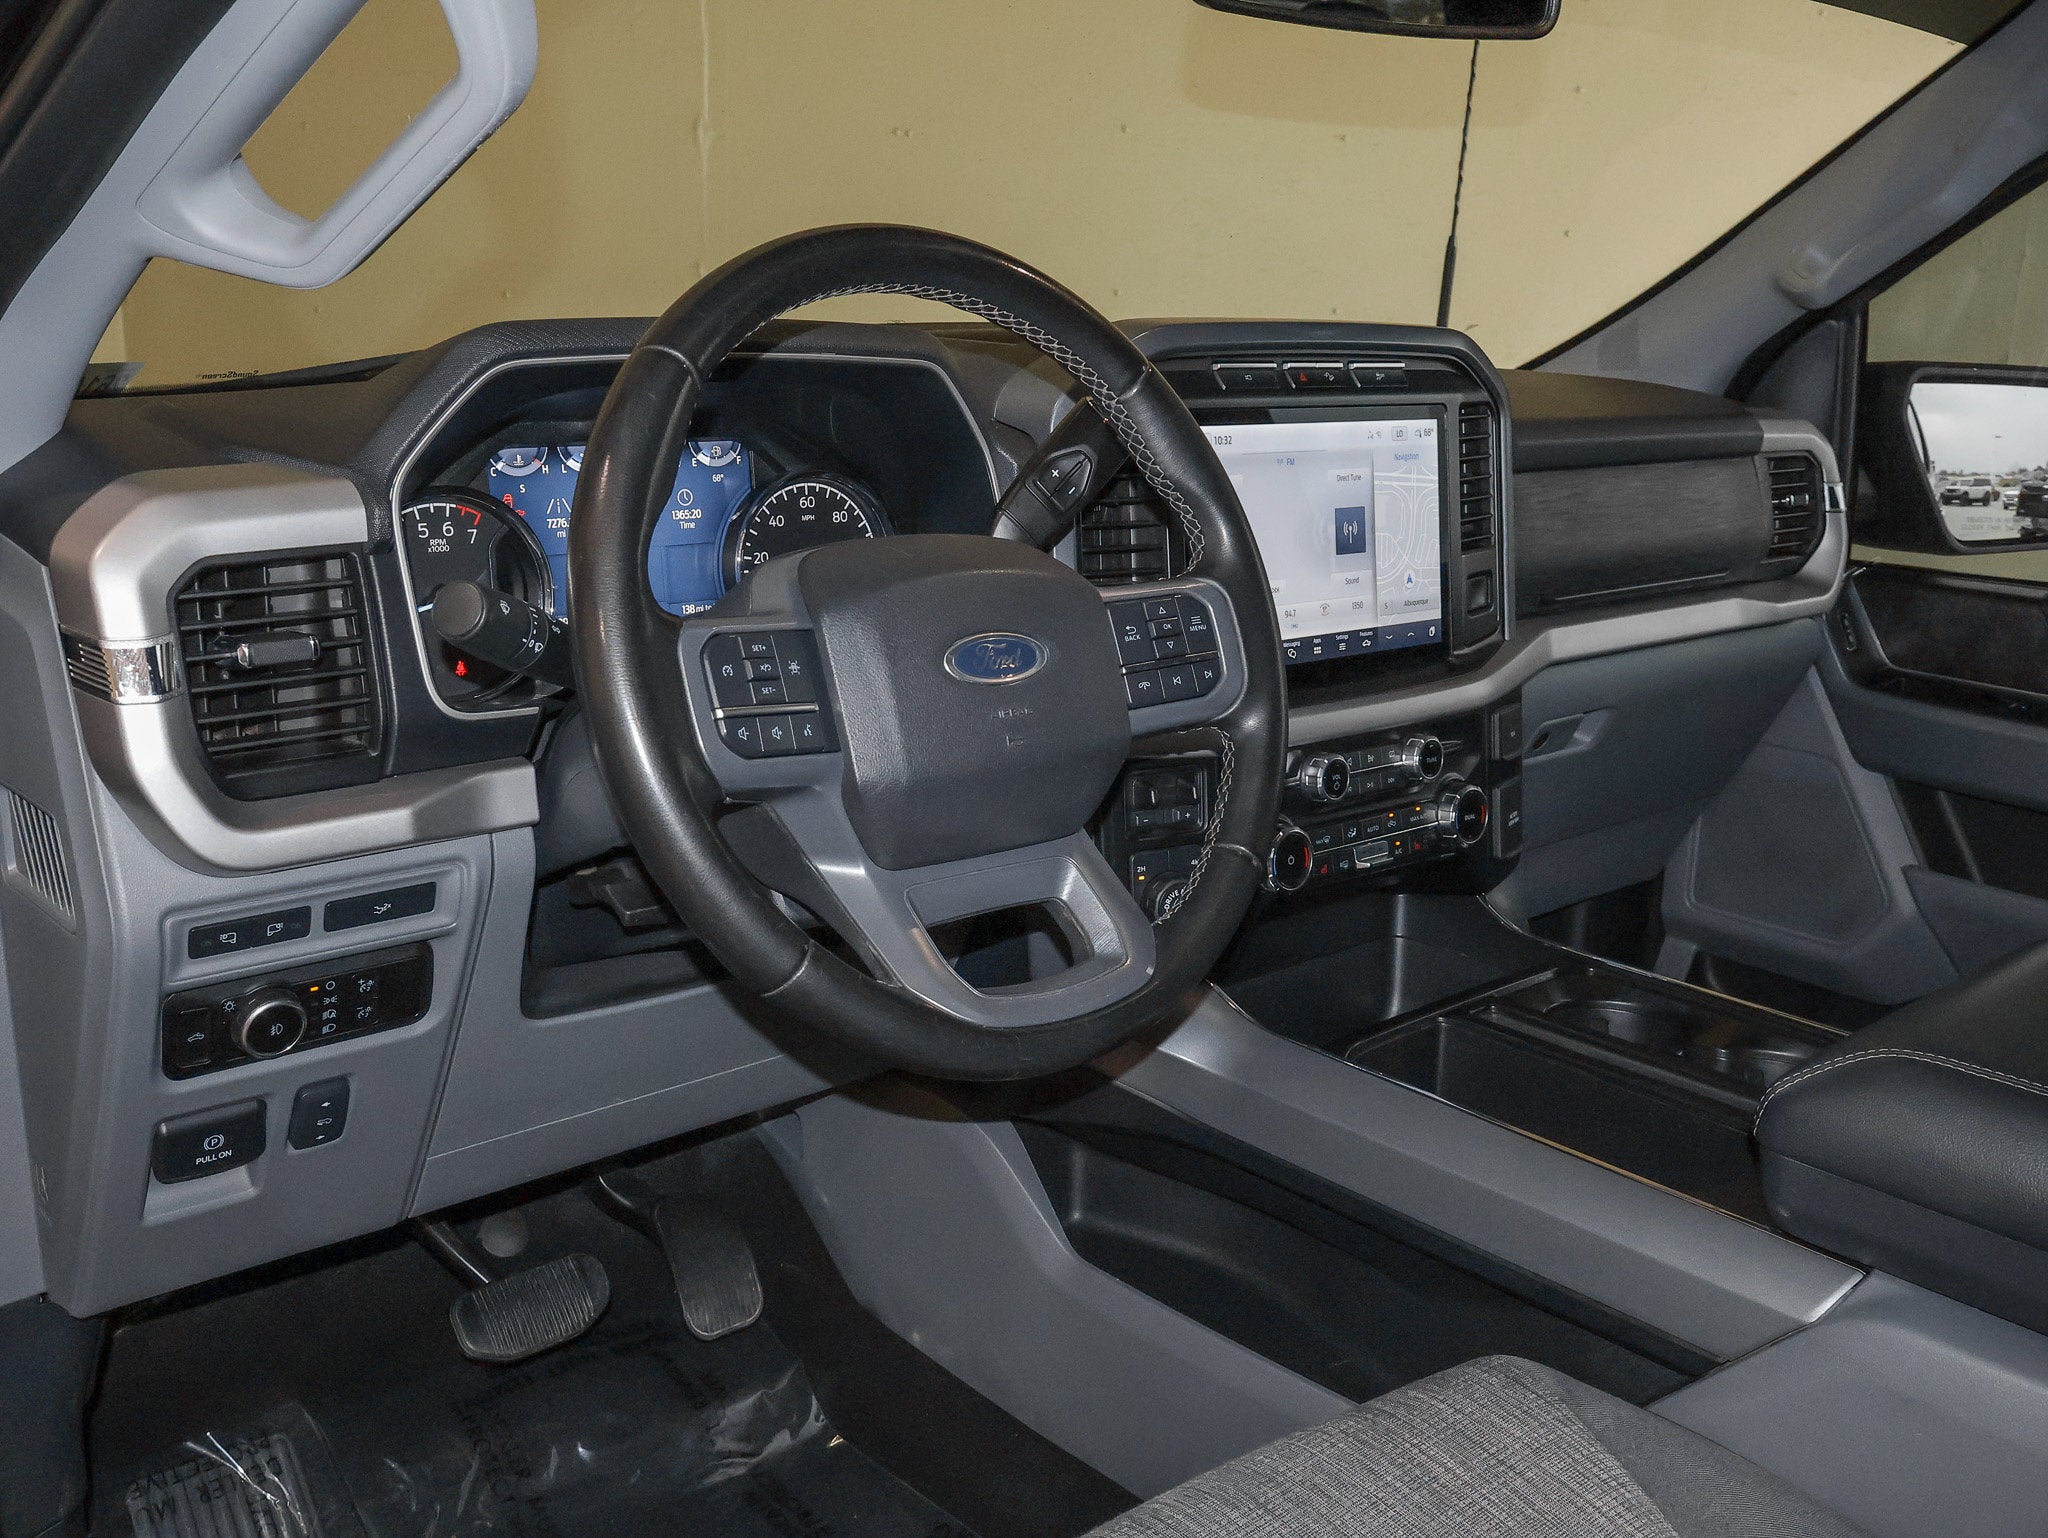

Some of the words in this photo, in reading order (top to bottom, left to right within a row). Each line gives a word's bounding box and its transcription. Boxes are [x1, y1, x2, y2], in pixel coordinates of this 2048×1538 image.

[1213, 435, 1233, 445] 10:32
[691, 458, 697, 467] E
[736, 456, 741, 464] F
[1287, 458, 1295, 466] FM
[490, 466, 497, 477] C
[541, 464, 549, 474] H
[561, 463, 567, 473] L
[1337, 474, 1350, 482] Direct
[1350, 473, 1361, 481] Tune
[519, 484, 526, 493] S
[799, 496, 815, 508] 60
[671, 508, 702, 520] 1365:20
[801, 514, 815, 522] MPH
[832, 510, 848, 522] 80
[546, 517, 572, 529] 7276.
[679, 521, 696, 529] Time
[768, 514, 784, 527] 40
[418, 523, 429, 538] 5
[442, 522, 454, 536] 6
[466, 529, 477, 544] 7
[556, 530, 566, 538] mi
[429, 538, 447, 546] RPM
[427, 545, 450, 553] x1000
[753, 551, 769, 565] 20
[1345, 576, 1359, 585] Sound
[681, 604, 697, 615] 138
[1352, 601, 1363, 610] 1350
[1284, 610, 1296, 618] 94.7
[1189, 624, 1207, 632] MENU
[1124, 634, 1141, 642] BACK
[1367, 824, 1380, 833] AUTO
[1136, 865, 1146, 873] 2H
[1164, 889, 1180, 910] DRIVE
[195, 1154, 218, 1166] PULL
[218, 1149, 233, 1159] ON
